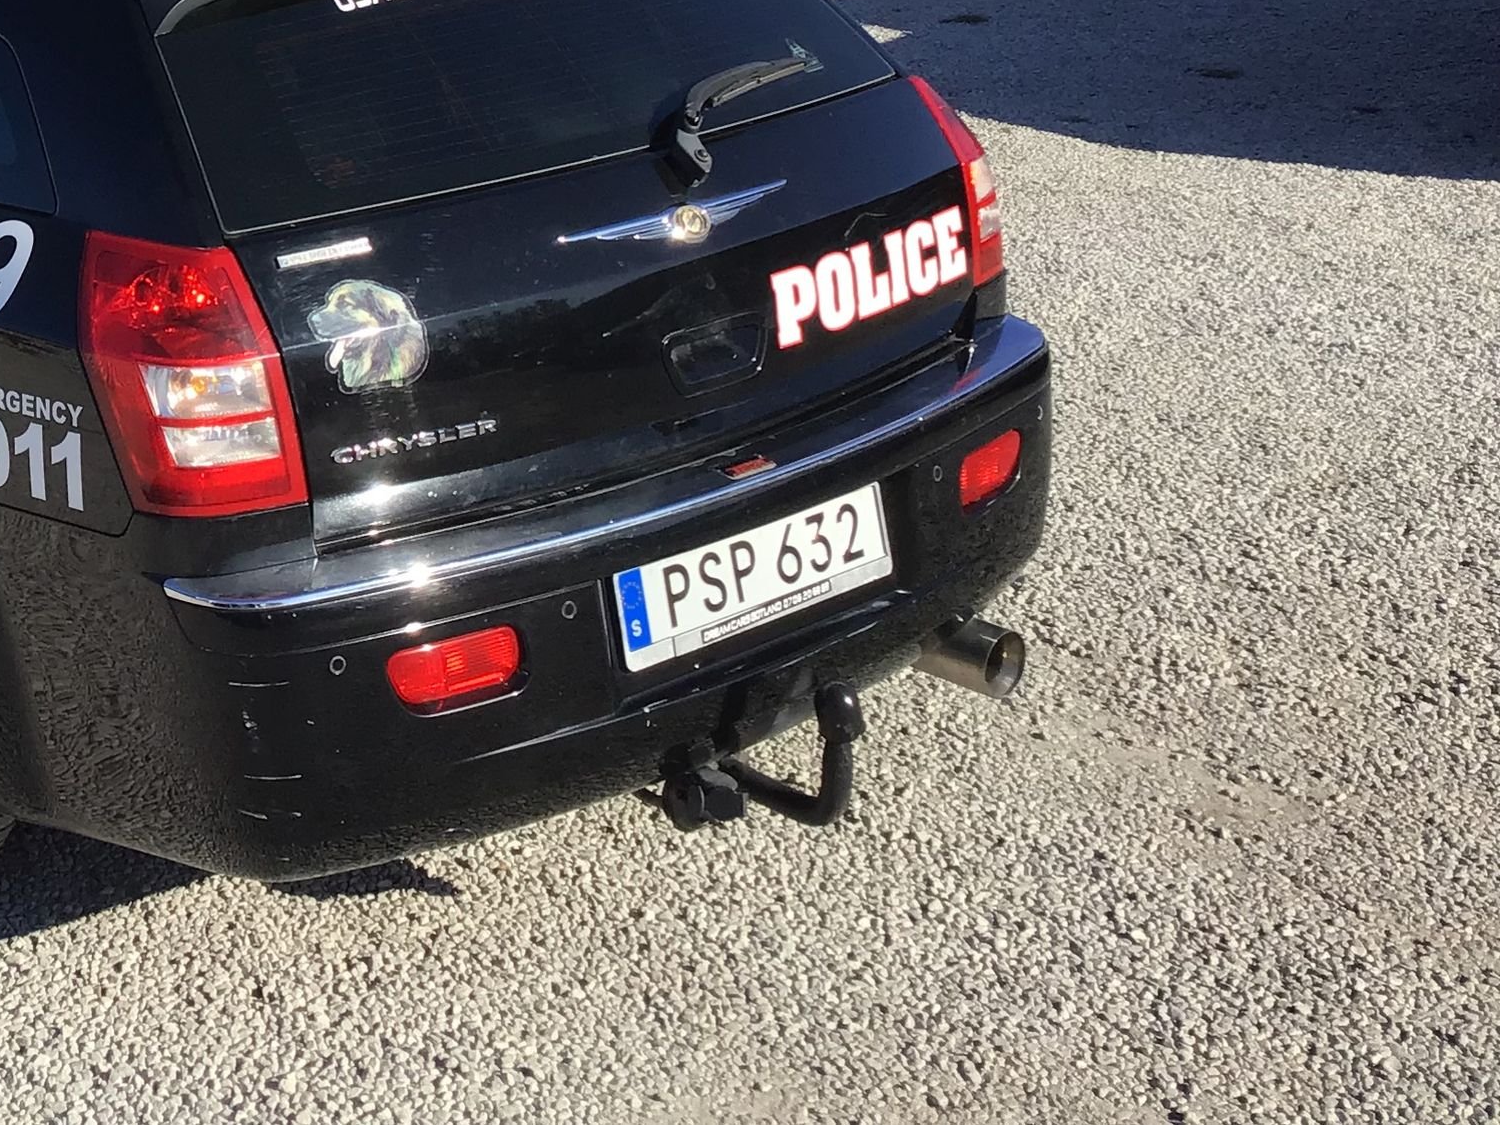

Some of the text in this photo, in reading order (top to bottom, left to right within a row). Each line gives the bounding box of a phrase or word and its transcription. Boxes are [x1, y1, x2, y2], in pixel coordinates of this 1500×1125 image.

[770, 205, 968, 350] POLICE
[330, 419, 497, 464] CHRYSLER
[662, 503, 864, 628] PSP 632
